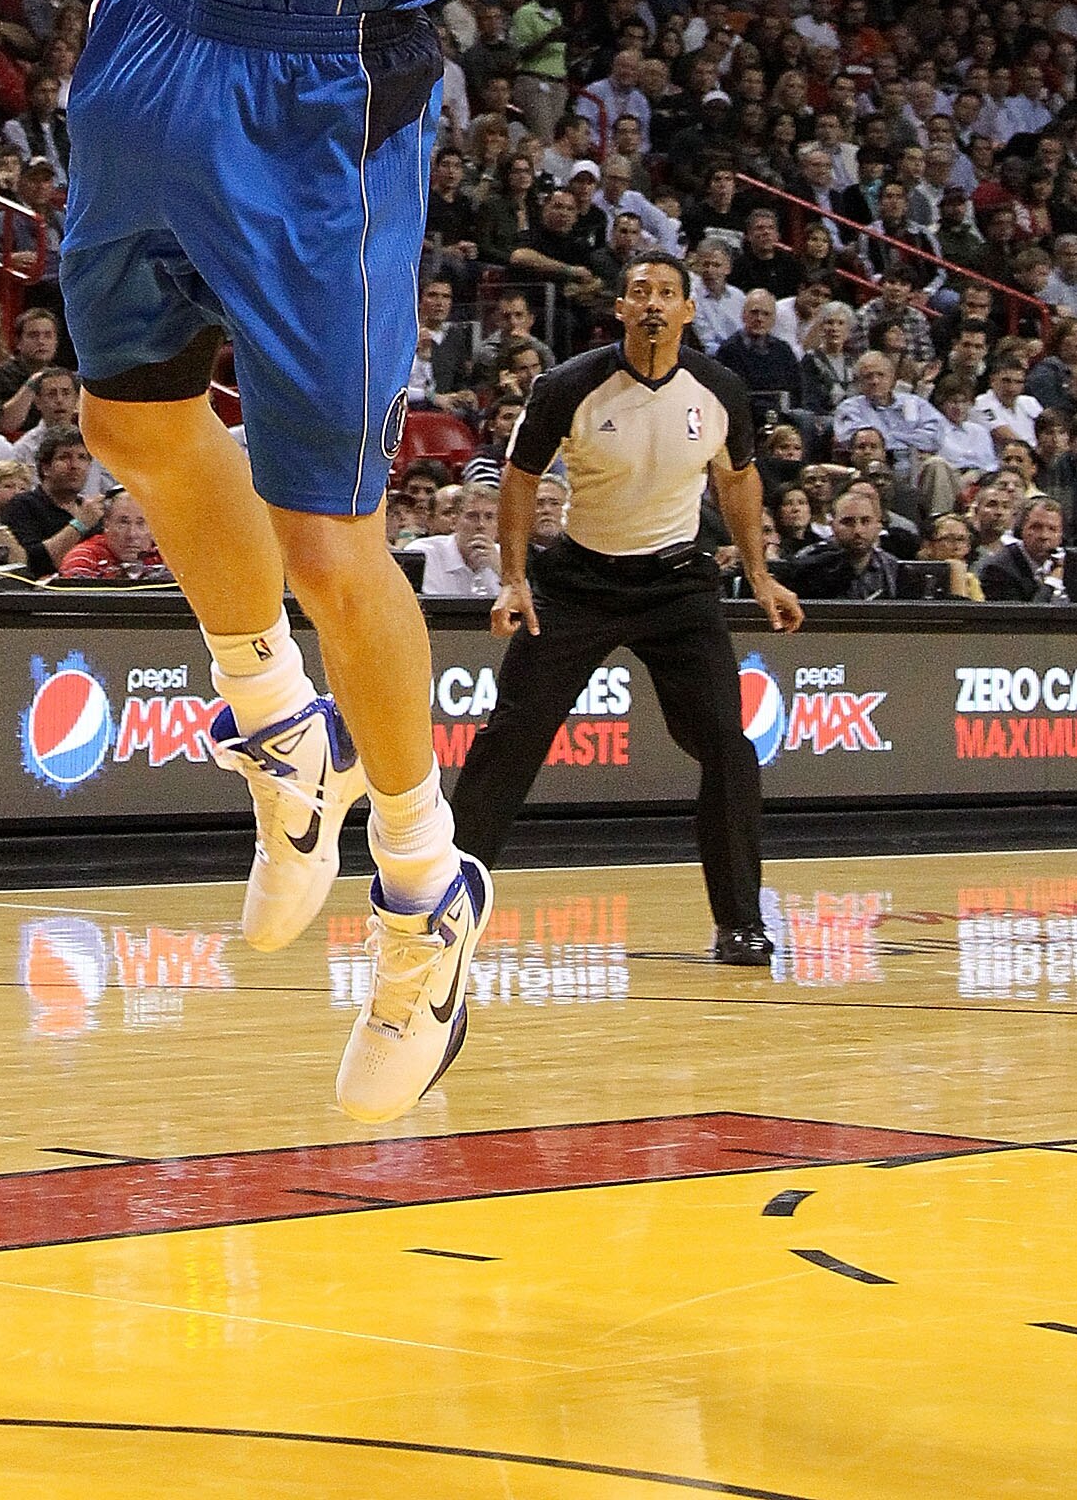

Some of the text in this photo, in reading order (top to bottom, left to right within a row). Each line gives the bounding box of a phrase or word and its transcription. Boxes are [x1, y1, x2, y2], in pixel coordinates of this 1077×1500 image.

[127, 665, 189, 692] pepsi
[795, 664, 845, 688] pepsi
[955, 667, 1040, 713] ZERO
[113, 697, 229, 768] MAX
[544, 721, 630, 767] ASTE
